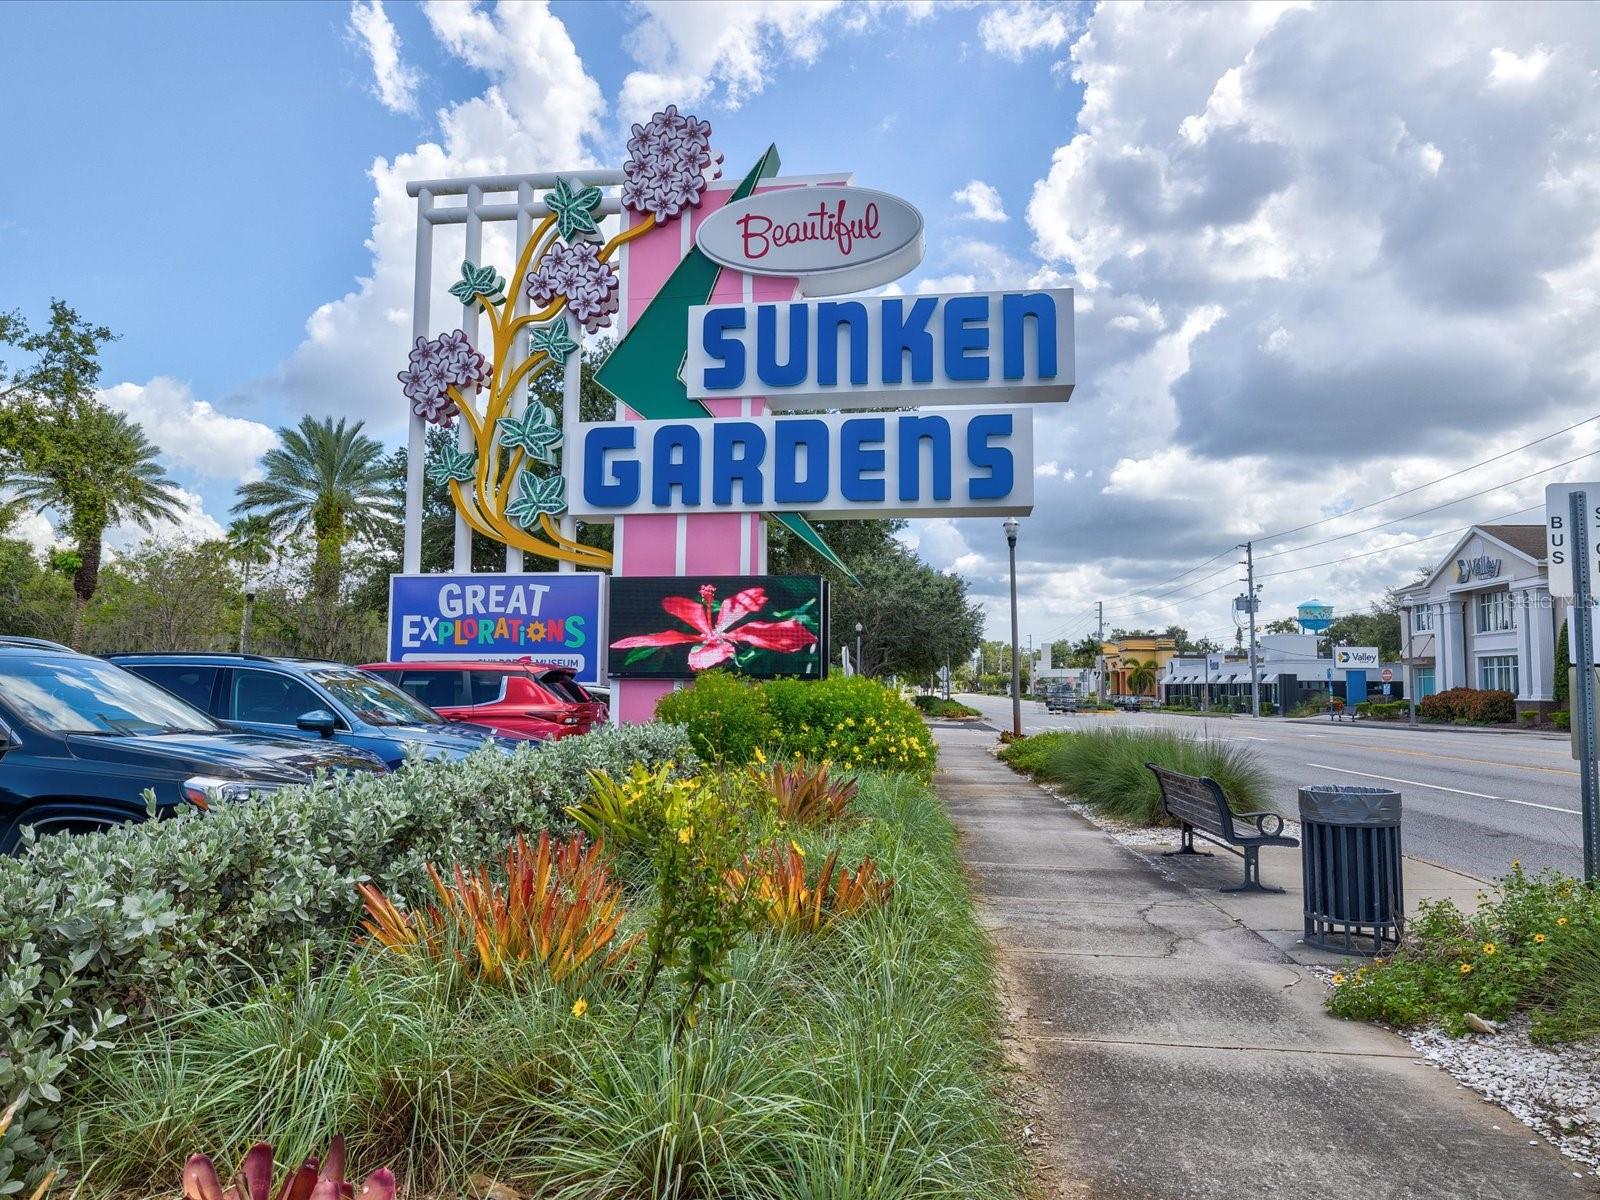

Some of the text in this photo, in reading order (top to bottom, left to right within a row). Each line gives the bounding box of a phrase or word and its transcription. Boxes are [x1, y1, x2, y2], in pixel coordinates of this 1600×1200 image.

[737, 200, 881, 259] Beautiful
[703, 293, 1057, 390] SUNKEN
[583, 414, 1014, 507] GARDENS
[1551, 516, 1565, 565] BUS
[438, 583, 550, 618] GREAT
[1352, 652, 1377, 664] Valley
